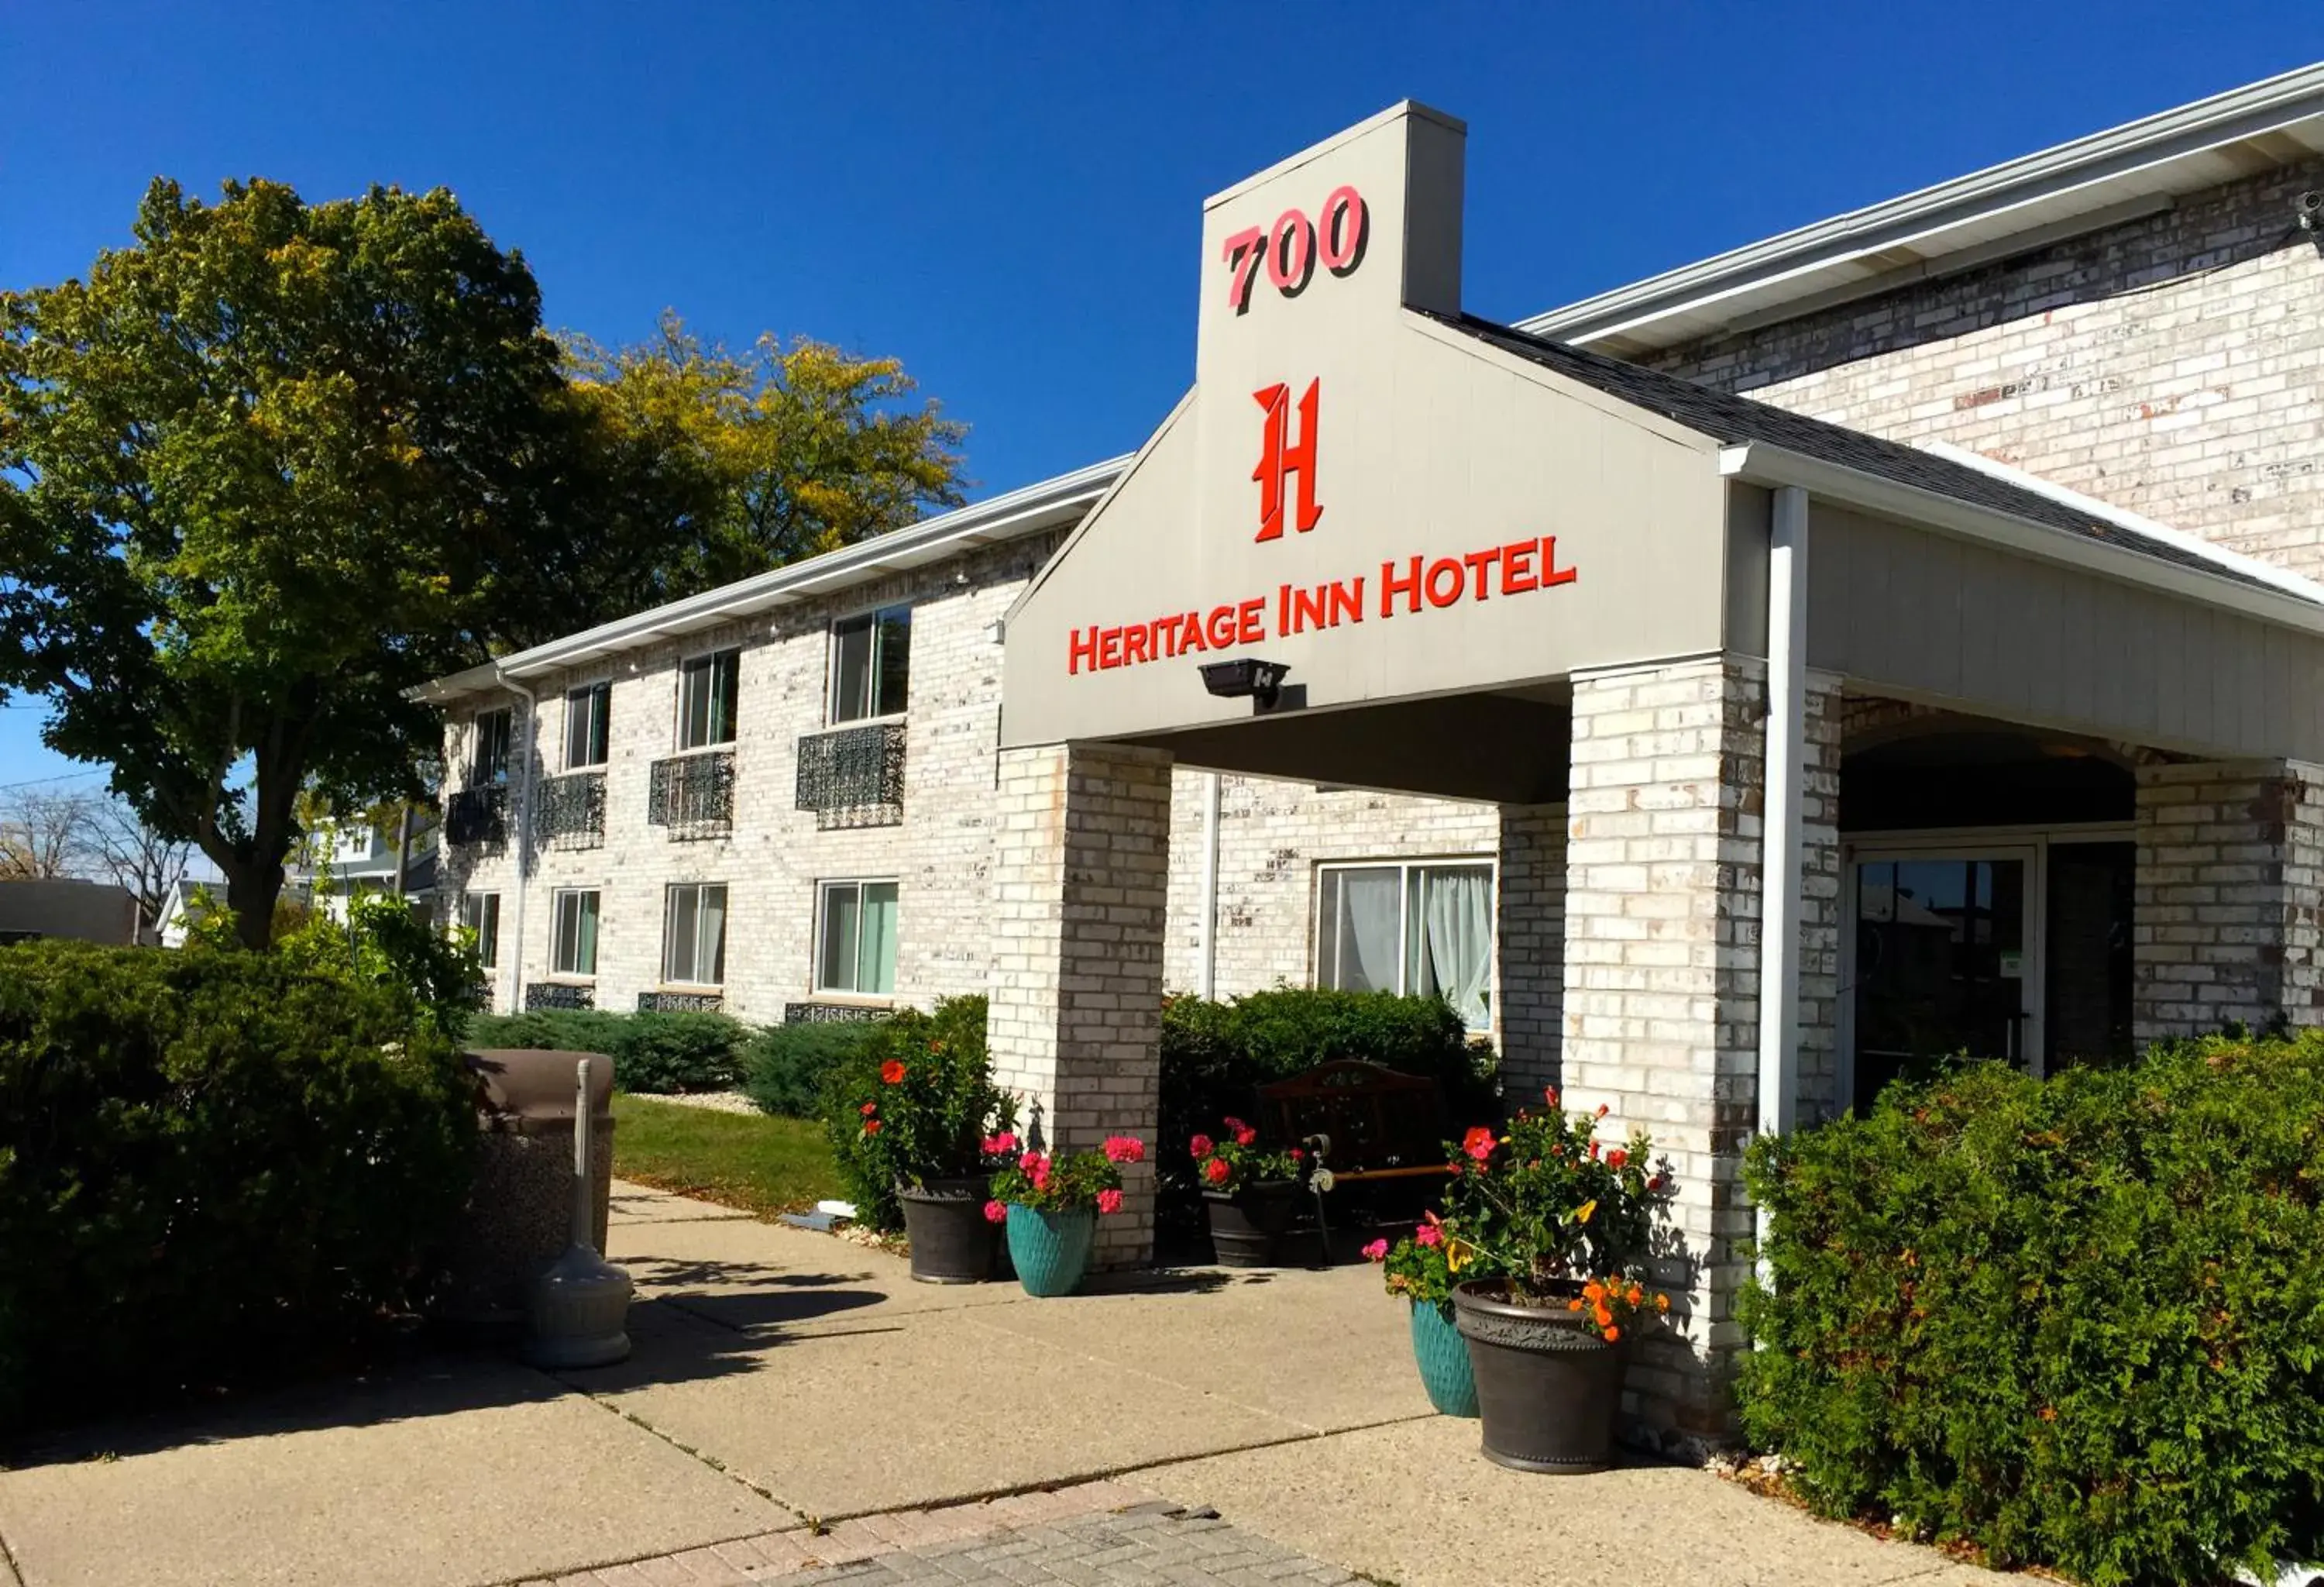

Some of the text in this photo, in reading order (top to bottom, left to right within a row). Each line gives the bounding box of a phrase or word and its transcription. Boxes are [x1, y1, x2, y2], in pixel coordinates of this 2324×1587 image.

[1222, 186, 1369, 317] 700
[1252, 377, 1323, 542] H
[1068, 535, 1577, 676] HERITAGE INN HOTEL
